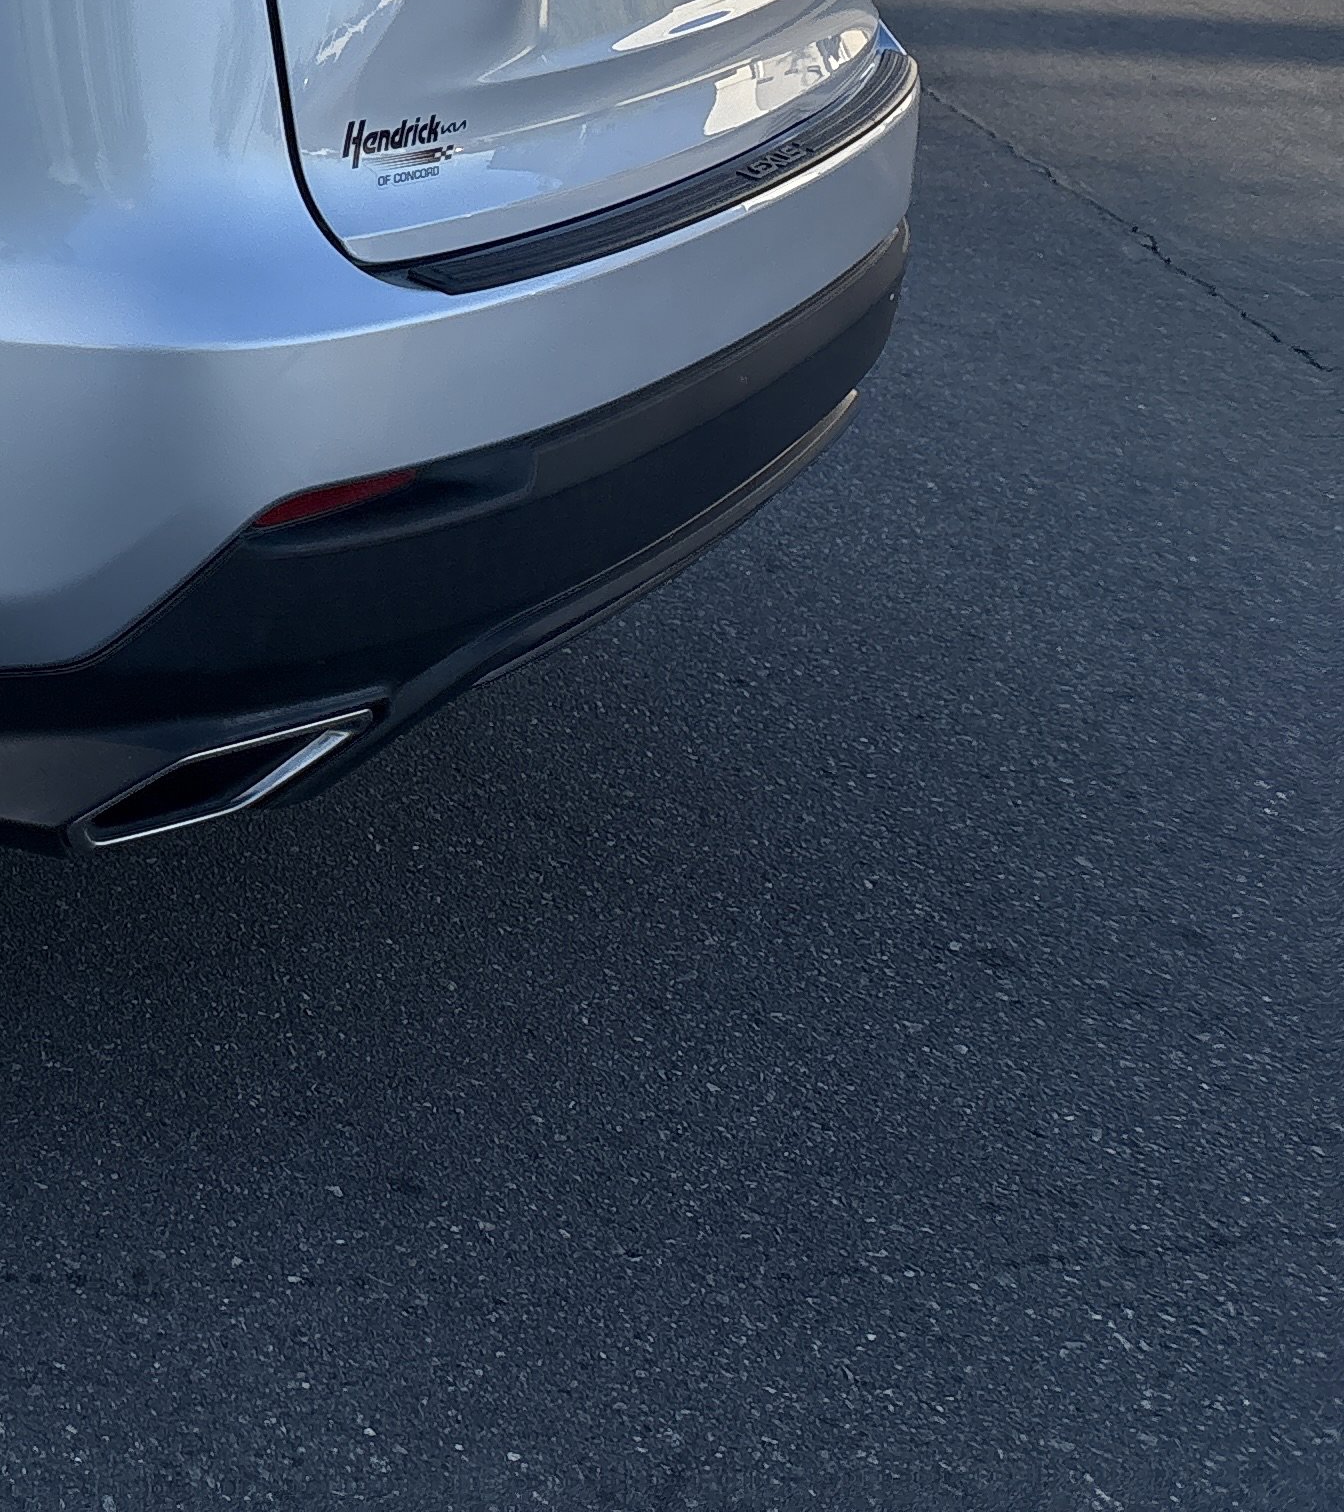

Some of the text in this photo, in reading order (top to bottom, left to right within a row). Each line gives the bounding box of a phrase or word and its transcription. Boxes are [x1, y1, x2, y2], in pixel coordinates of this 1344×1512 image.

[342, 114, 441, 169] Hendrick
[377, 165, 440, 187] OF CONCORD
